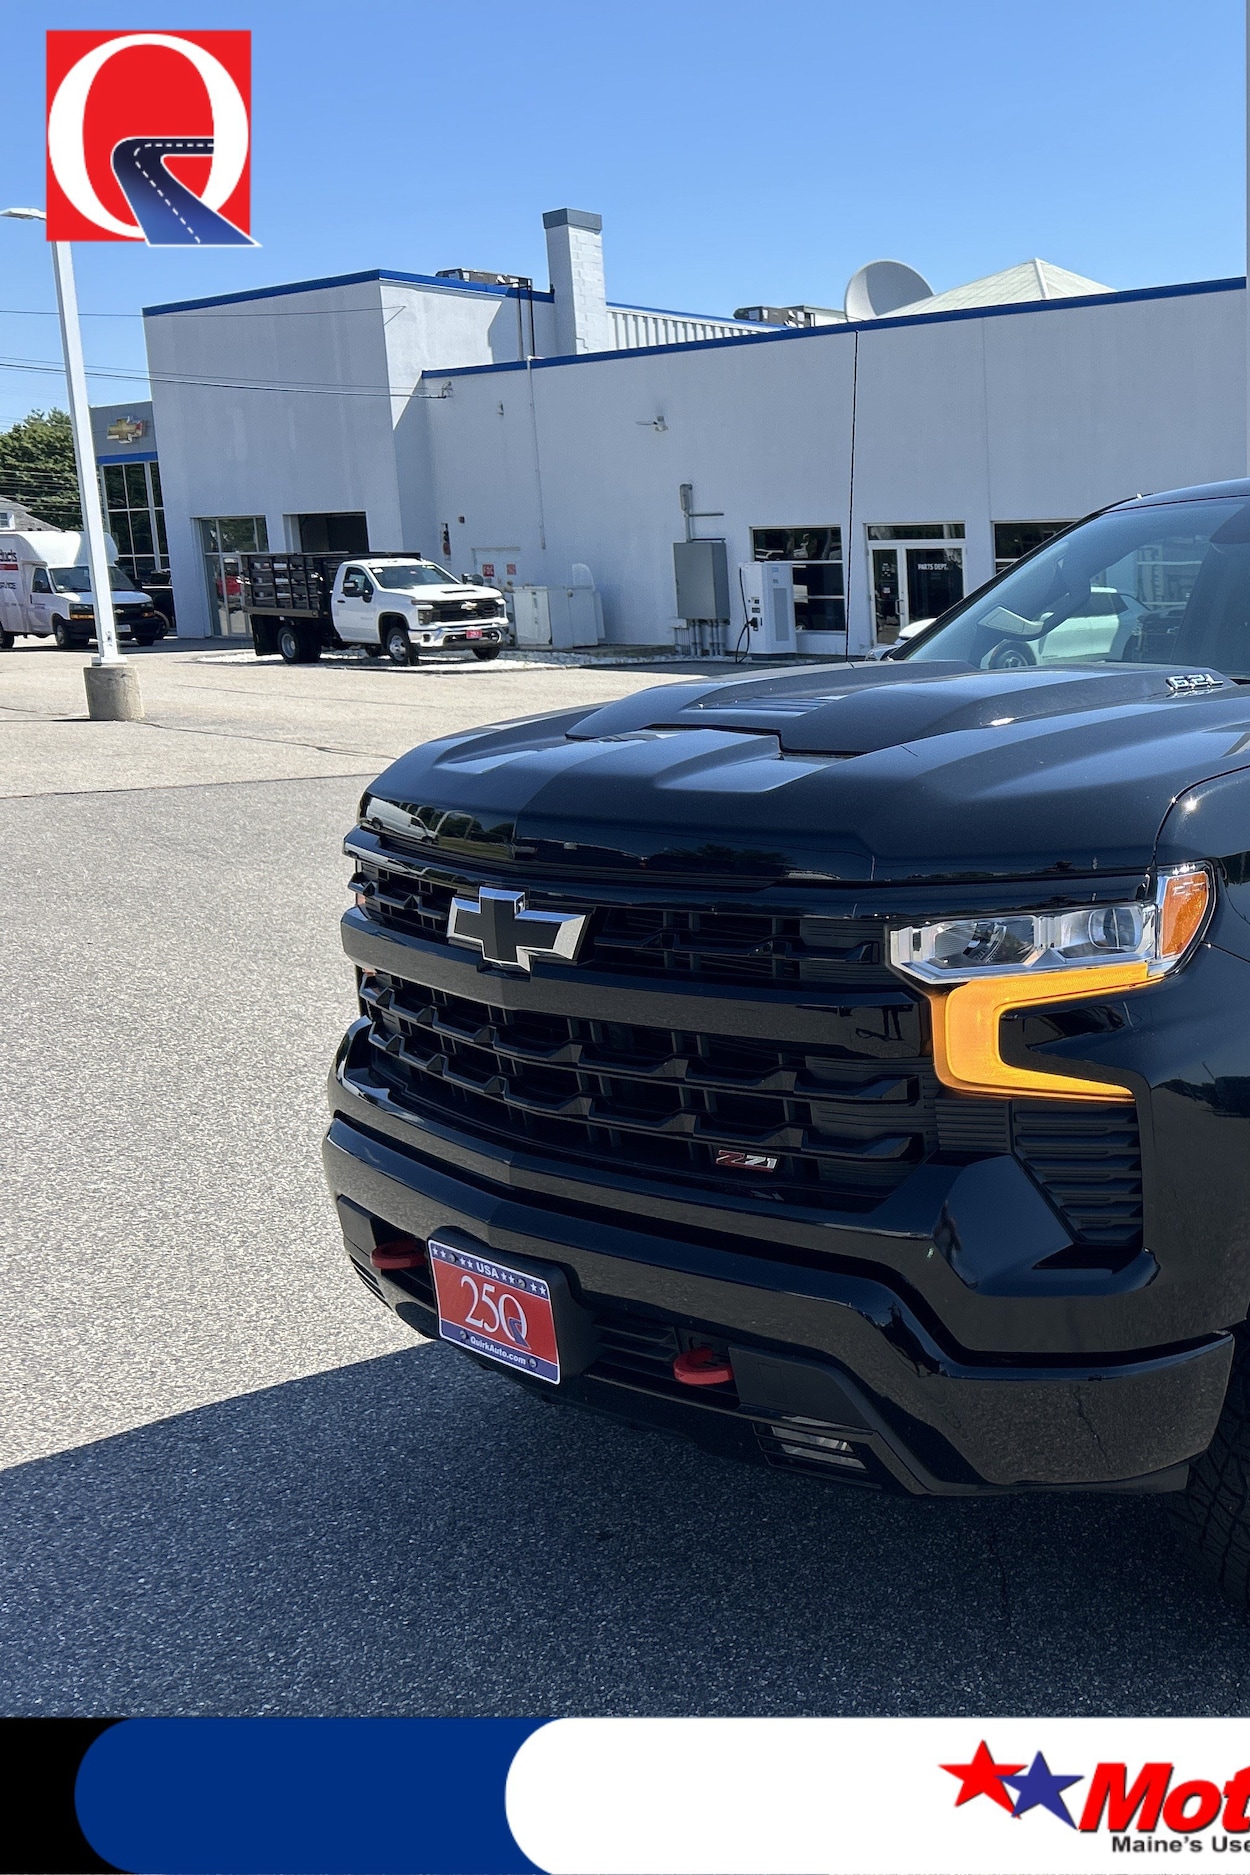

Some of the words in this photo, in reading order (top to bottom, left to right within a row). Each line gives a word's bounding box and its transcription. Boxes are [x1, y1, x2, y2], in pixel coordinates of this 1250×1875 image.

[715, 1149, 778, 1173] Z71
[475, 1261, 500, 1280] USA
[469, 1335, 527, 1366] QuirkAuto.com
